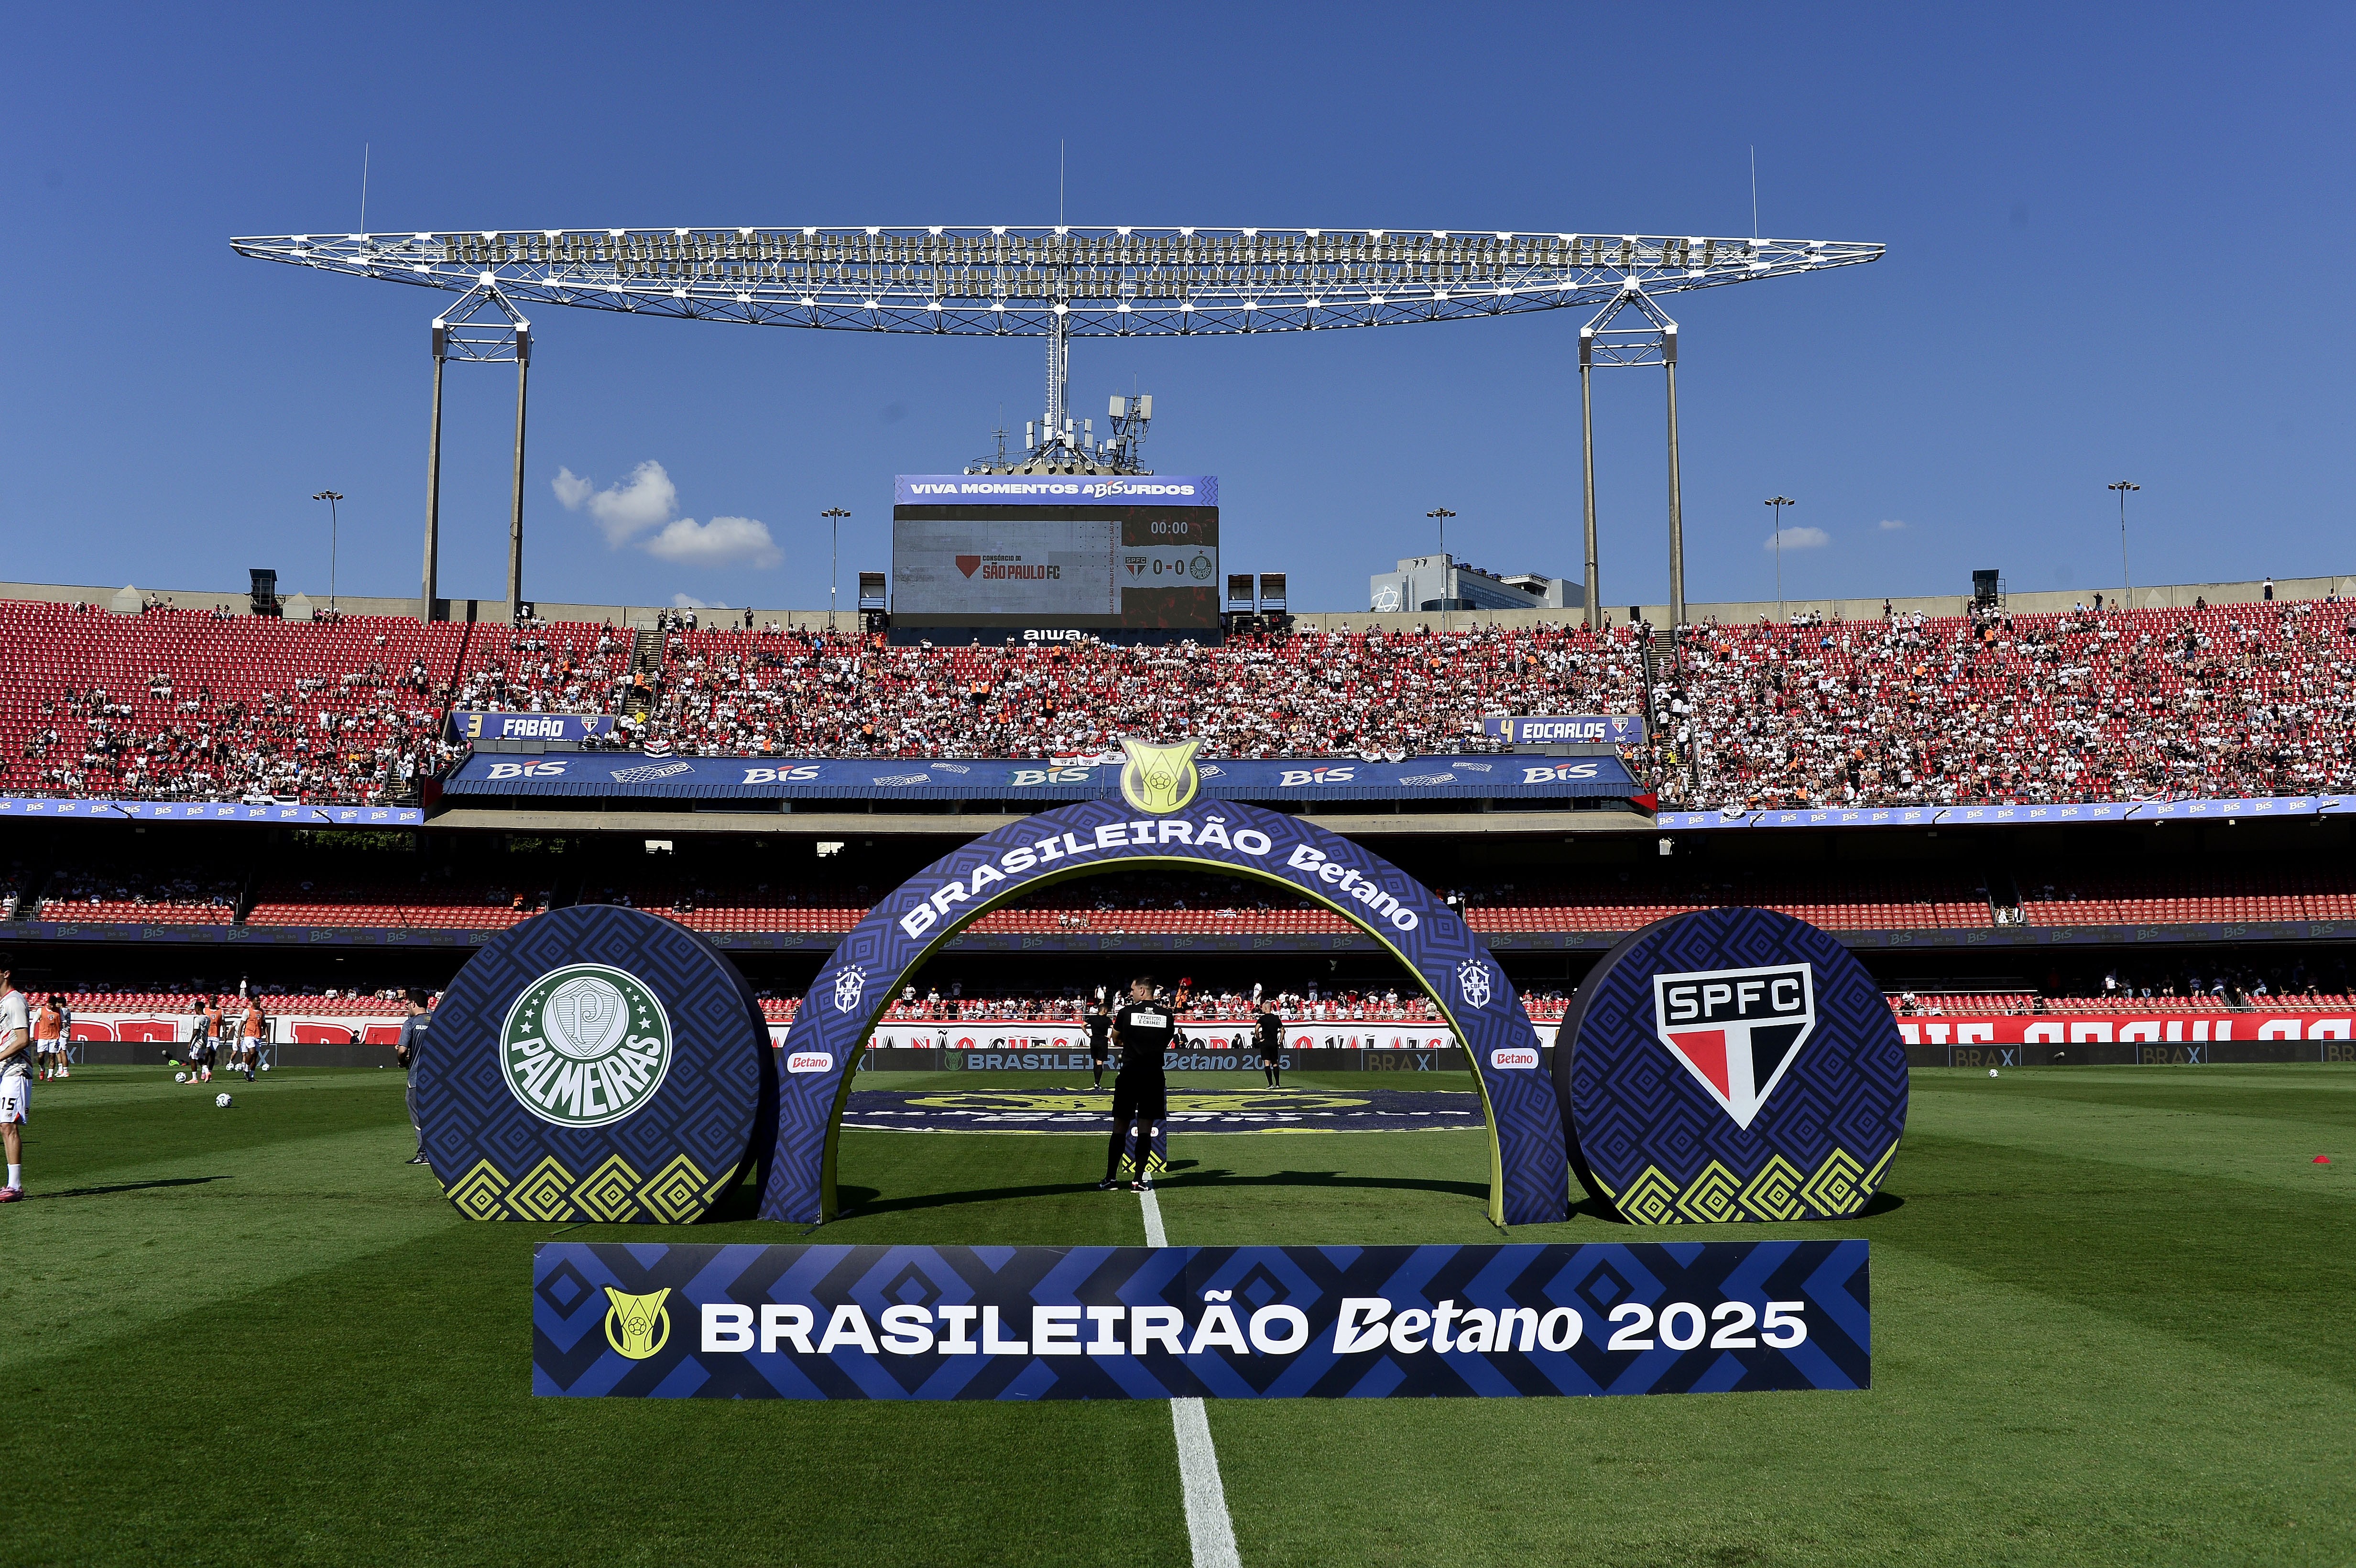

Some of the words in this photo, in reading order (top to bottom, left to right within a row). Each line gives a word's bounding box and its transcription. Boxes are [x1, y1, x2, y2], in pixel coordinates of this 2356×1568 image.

[910, 484, 958, 494] VIVA
[961, 484, 1079, 495] MOMENTOS
[1151, 522, 1188, 534] 00:00
[982, 562, 1006, 579] SÃO
[1007, 565, 1045, 579] PAULO
[1047, 565, 1060, 579] FC
[1153, 559, 1163, 575] 0
[1175, 560, 1185, 575] 0
[1023, 630, 1080, 640] aiwa
[467, 714, 483, 738] 3
[502, 717, 565, 737] FABÃO
[1500, 719, 1515, 743] 4
[1522, 722, 1606, 739] EDCARLOS
[900, 816, 1272, 940] BRASILEIRÃO
[1287, 843, 1418, 931] Betano
[1669, 978, 1800, 1020] SPFC
[792, 1056, 828, 1069] Betano
[1163, 1053, 1237, 1070] Betano
[1242, 1054, 1290, 1070] 205
[1369, 1054, 1430, 1071] BRAX
[1497, 1053, 1533, 1064] Betano
[1956, 1049, 2014, 1066] BRAX
[2143, 1047, 2201, 1064] BRAX
[511, 1034, 661, 1117] PALMEIRAS
[1, 1098, 17, 1111] 15
[701, 1289, 1309, 1355] BRASILEIRÃO
[1332, 1297, 1583, 1355] Betano
[1607, 1300, 1808, 1351] 2025
